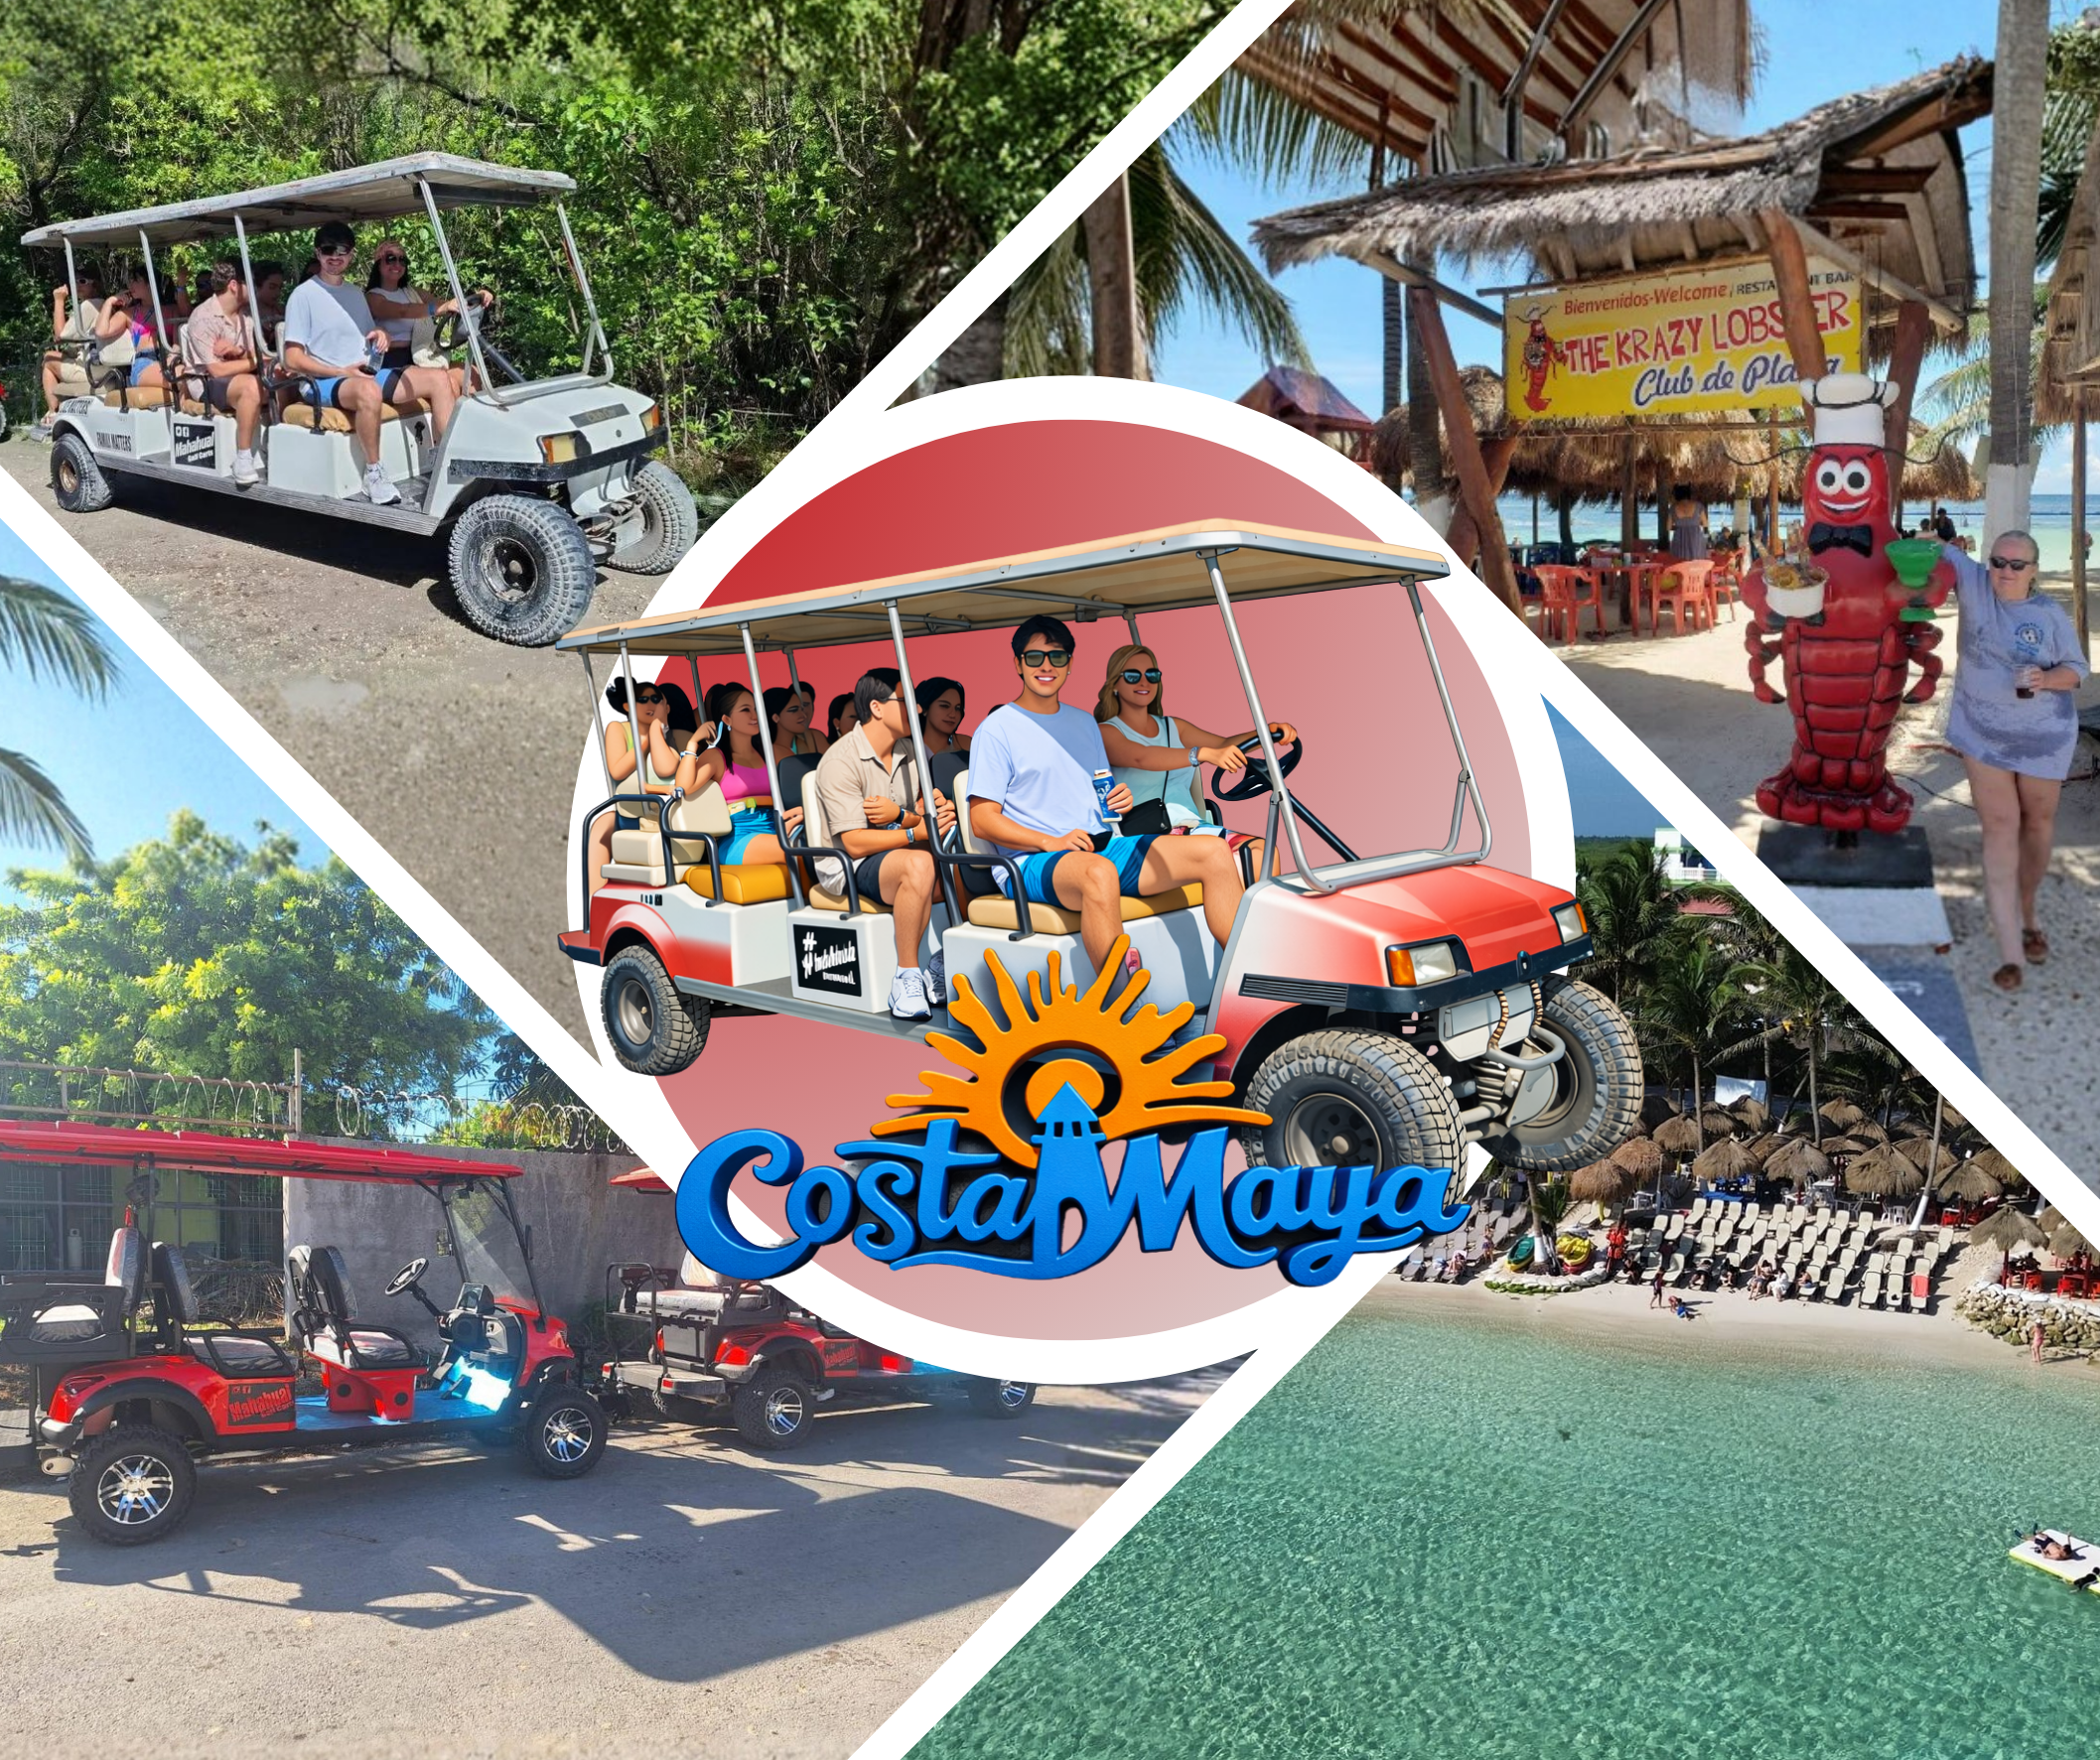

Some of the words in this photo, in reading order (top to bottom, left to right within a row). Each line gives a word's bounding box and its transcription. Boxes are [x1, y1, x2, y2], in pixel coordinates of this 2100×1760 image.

[1564, 284, 1728, 315] Bienvenidos-Welcome
[1737, 274, 1820, 295] RESTAT
[1826, 271, 1854, 285] BAR
[1565, 335, 1610, 374] THE
[1615, 317, 1704, 366] KRAZY
[1711, 291, 1852, 350] LOBSER
[1634, 365, 1694, 407] Club
[1700, 360, 1736, 393] de
[1742, 353, 1841, 394] Plaa
[176, 431, 214, 458] Mahahual
[228, 1383, 292, 1422] Mahahual
